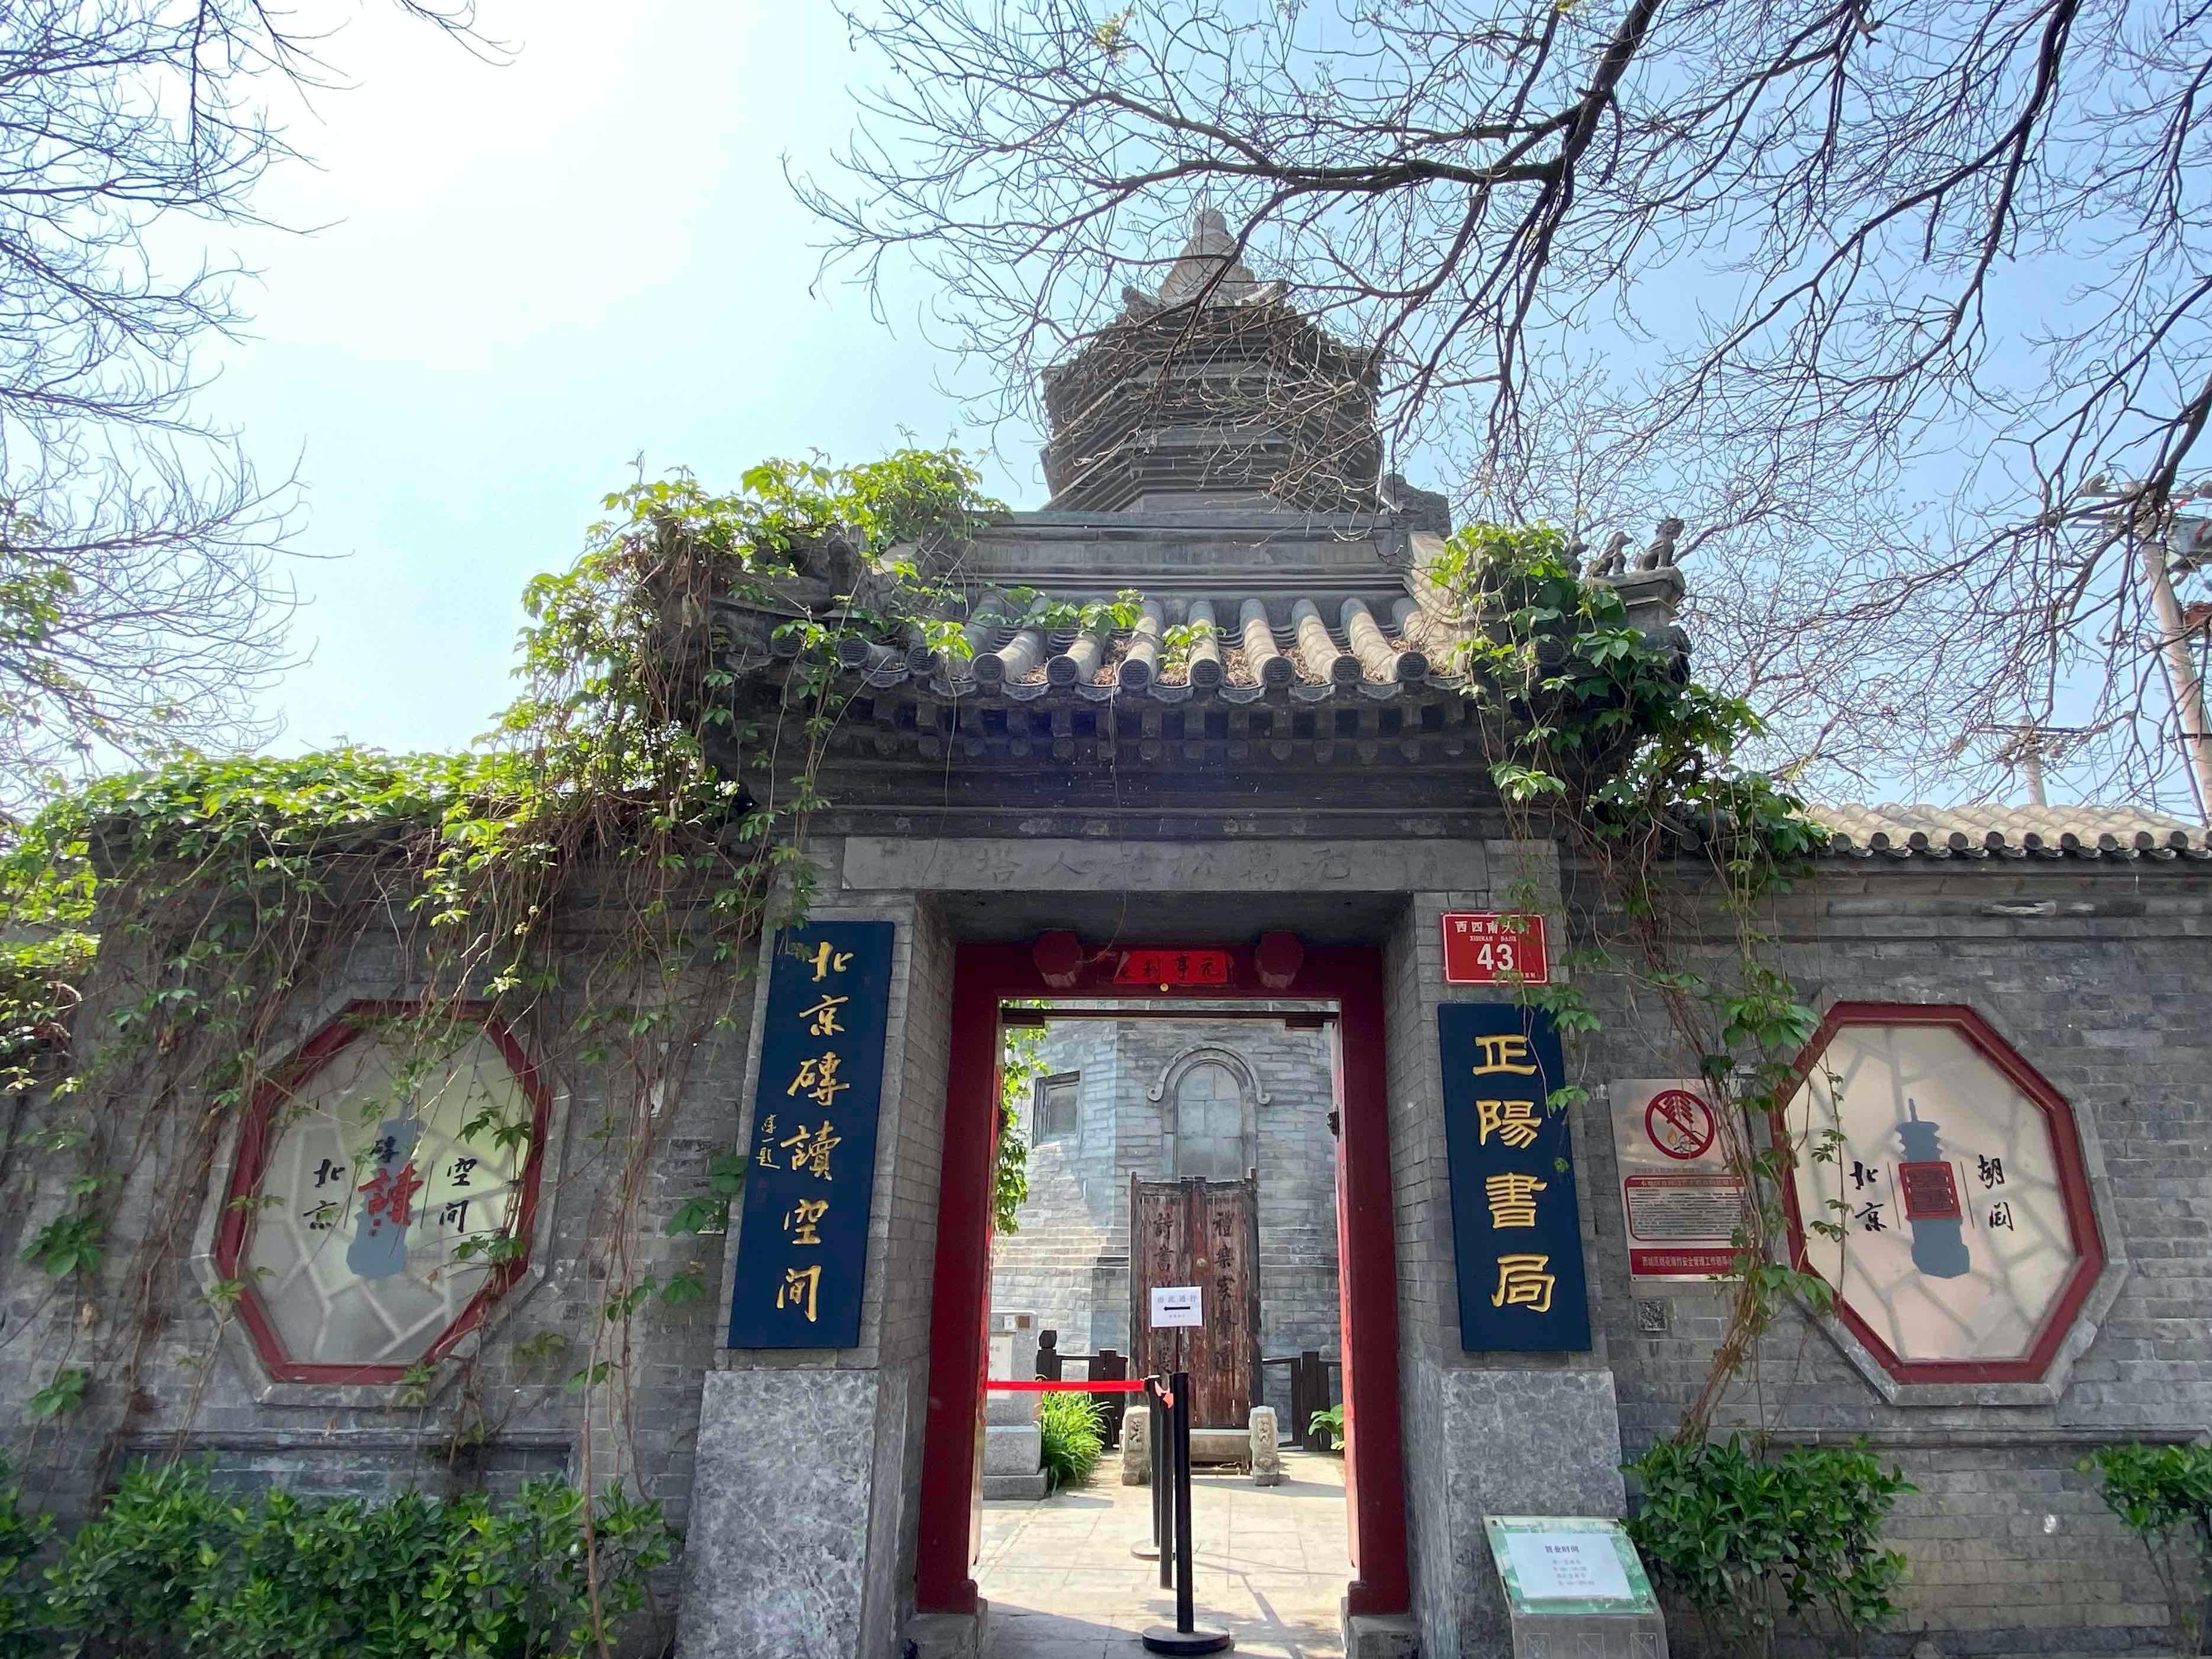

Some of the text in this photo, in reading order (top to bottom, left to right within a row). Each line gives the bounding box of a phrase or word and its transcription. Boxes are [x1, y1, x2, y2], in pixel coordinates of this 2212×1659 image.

[1455, 921, 1530, 934] 西四南大
[1477, 943, 1514, 971] 43
[303, 1159, 345, 1229] 北京
[1472, 1034, 1556, 1312] 正陽書局
[1849, 1161, 1887, 1231] 北京
